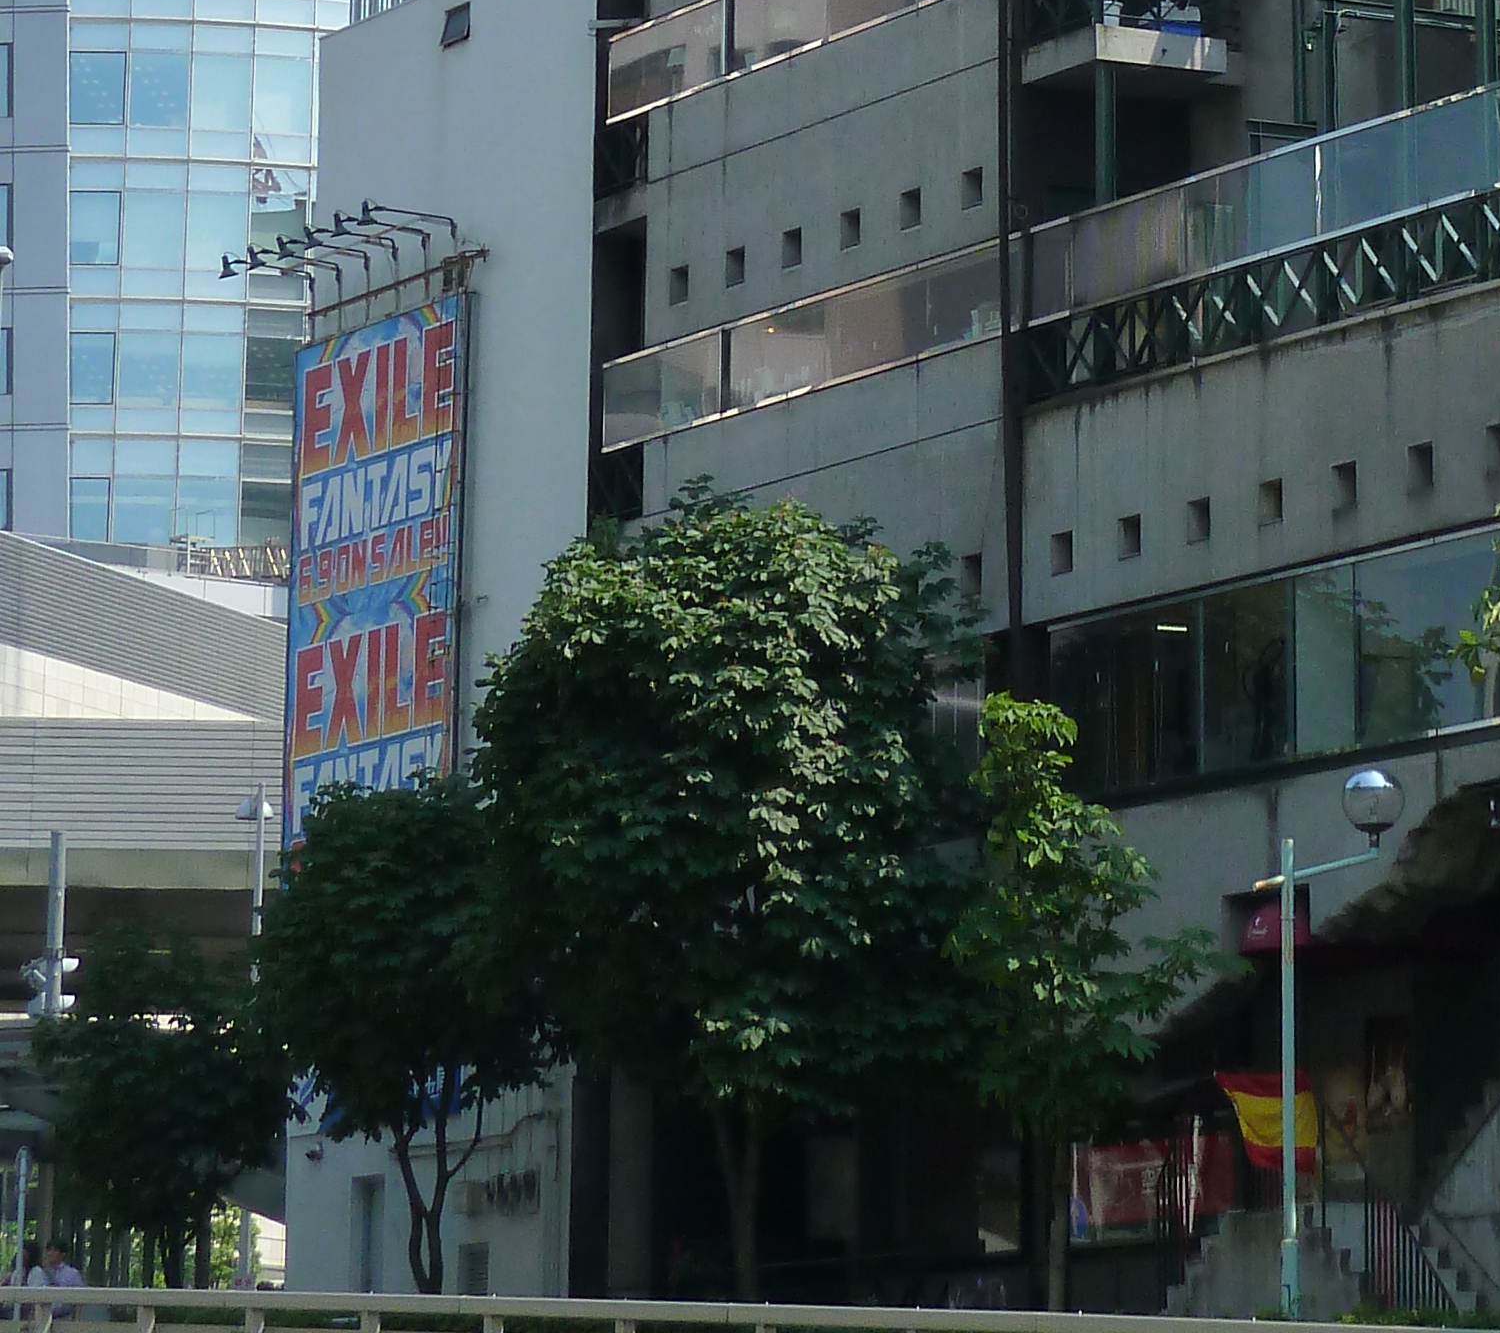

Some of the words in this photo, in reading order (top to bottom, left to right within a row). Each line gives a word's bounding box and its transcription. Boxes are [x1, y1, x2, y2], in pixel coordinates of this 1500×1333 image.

[300, 318, 456, 479] EXILE
[300, 438, 453, 552] FANTASY
[293, 608, 446, 761] EXILE
